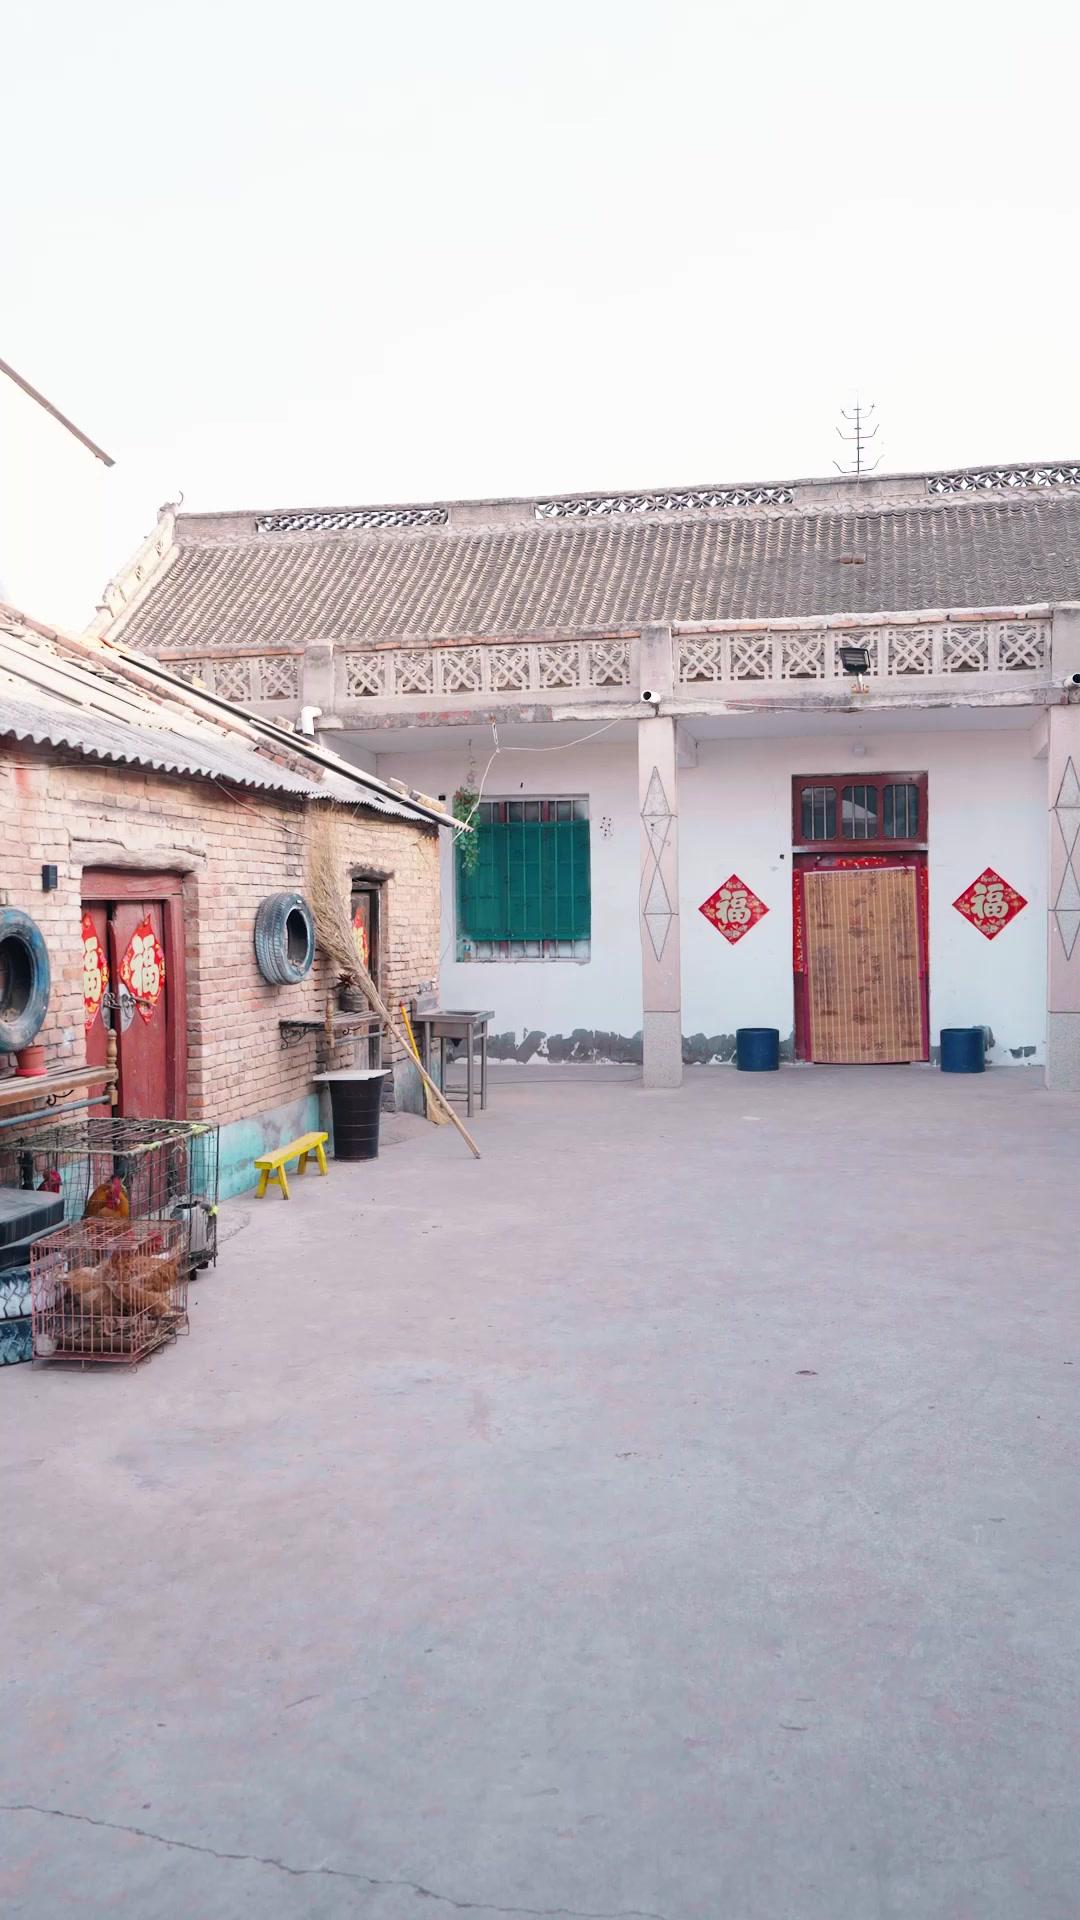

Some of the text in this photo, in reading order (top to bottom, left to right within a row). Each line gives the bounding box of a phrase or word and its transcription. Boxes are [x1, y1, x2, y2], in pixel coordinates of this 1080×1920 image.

[716, 888, 752, 925] 福
[970, 882, 1009, 919] 福
[130, 933, 160, 997] 福
